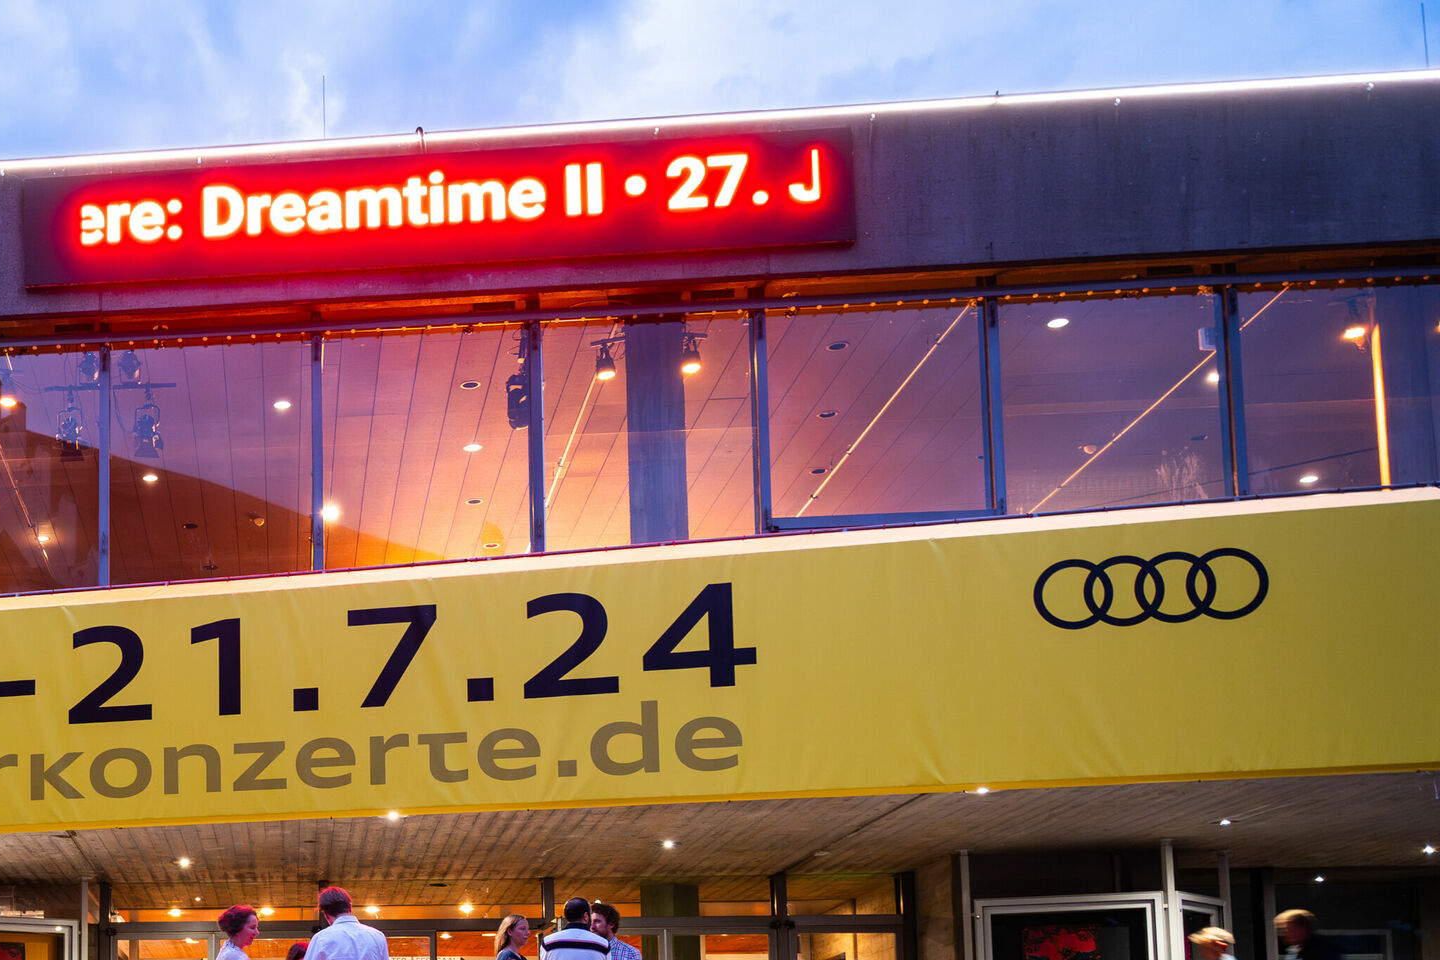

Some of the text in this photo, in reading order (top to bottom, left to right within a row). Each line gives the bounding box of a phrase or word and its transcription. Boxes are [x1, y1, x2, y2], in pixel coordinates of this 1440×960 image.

[81, 199, 182, 245] ere:
[202, 171, 547, 239] Dreamtime
[565, 163, 604, 217] II
[666, 154, 770, 210] 27.
